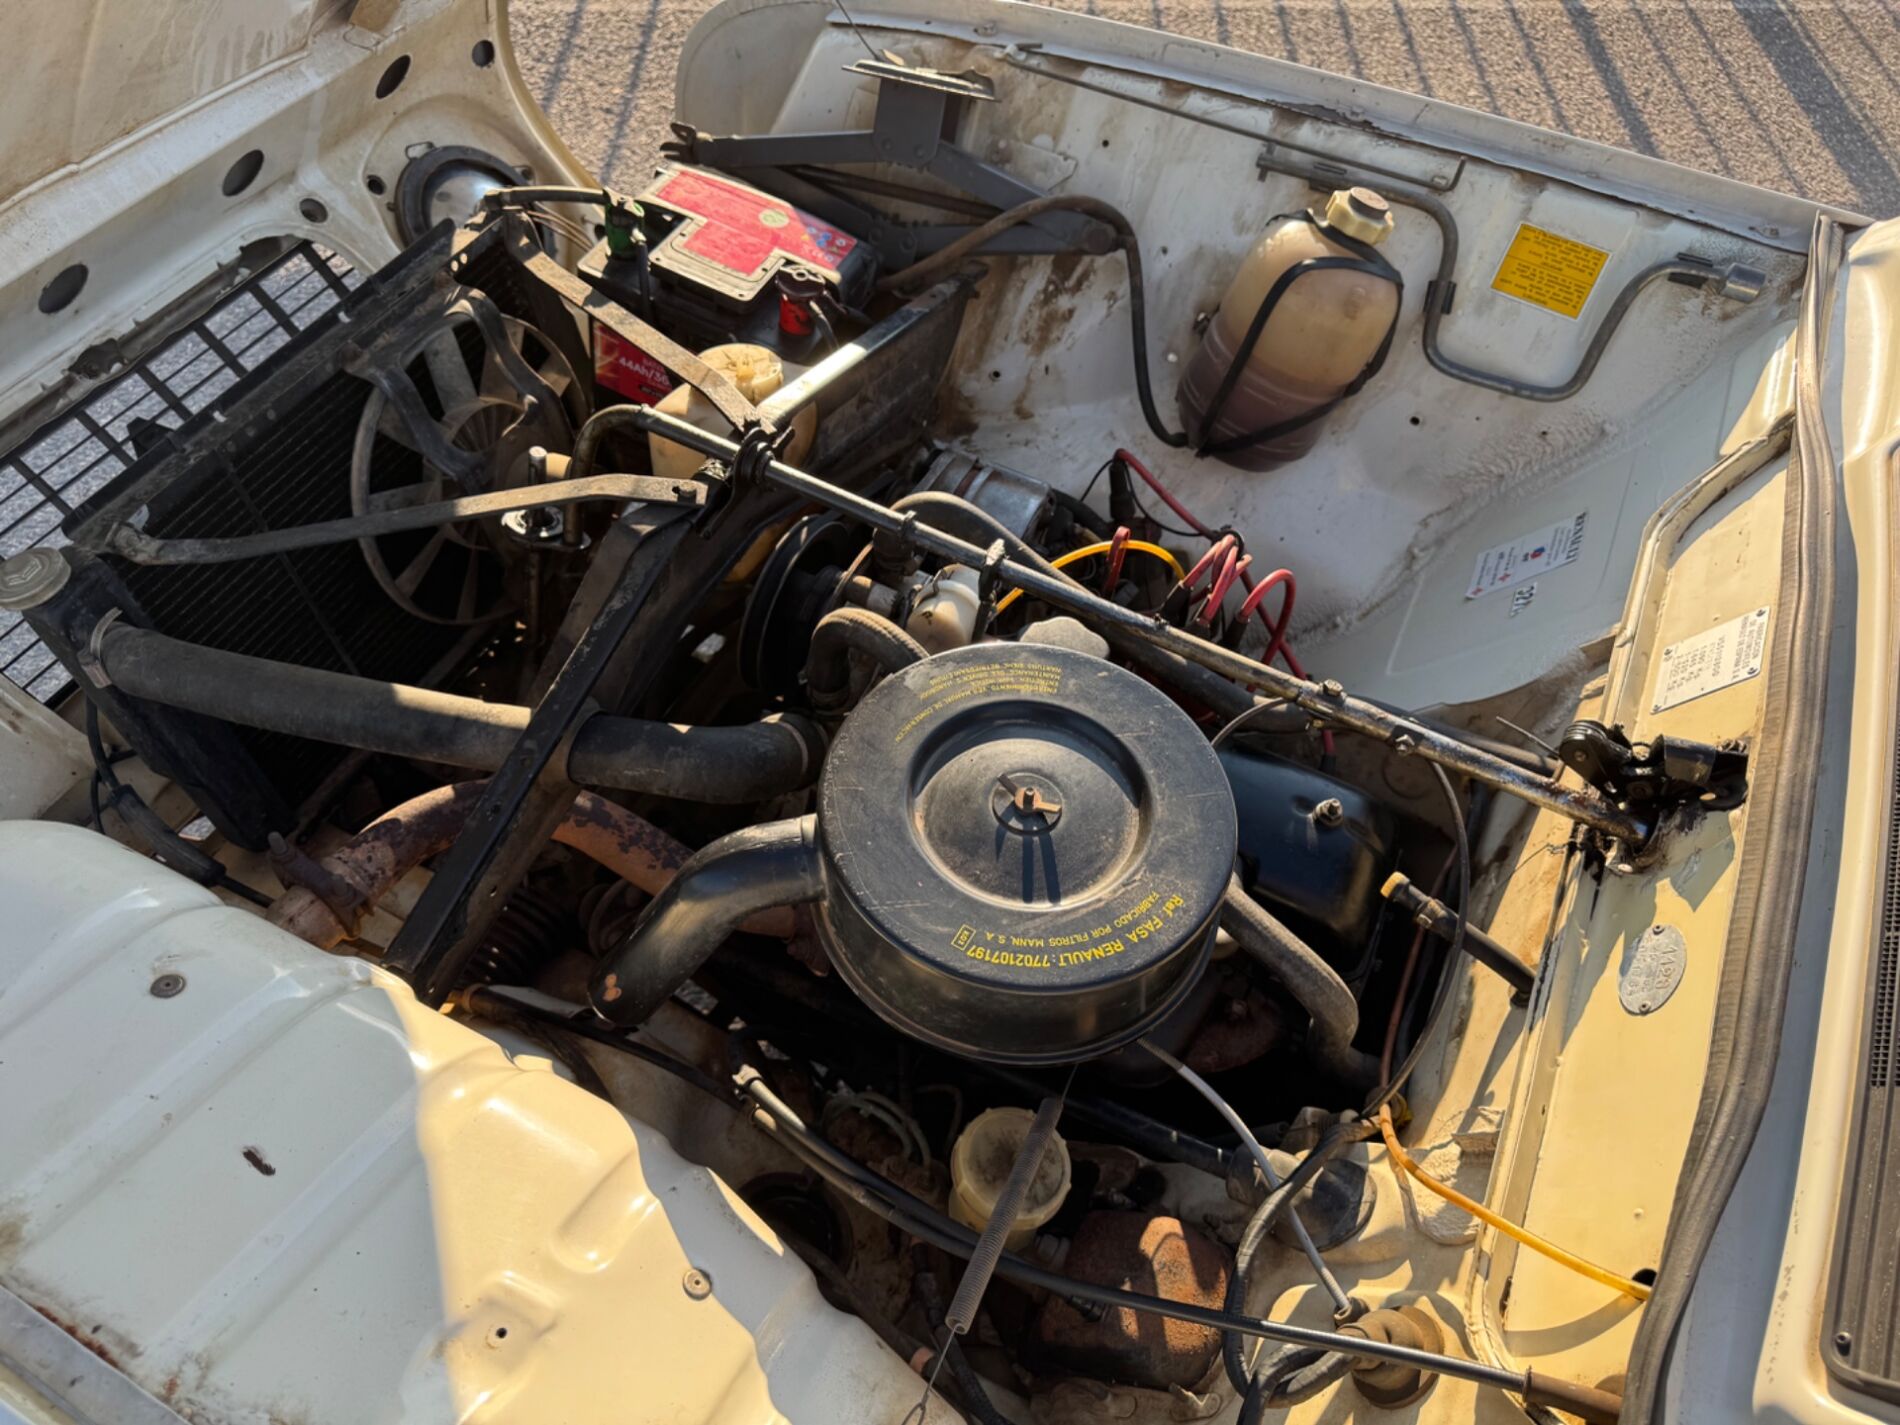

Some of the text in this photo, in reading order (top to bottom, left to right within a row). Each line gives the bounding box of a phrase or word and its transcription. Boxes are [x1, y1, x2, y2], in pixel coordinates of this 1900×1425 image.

[1113, 891, 1160, 928] FABRICADO
[1049, 931, 1090, 947] FILTROS
[1091, 924, 1112, 939] POR
[1125, 915, 1164, 943] FASA
[967, 944, 1051, 968] 7702107197
